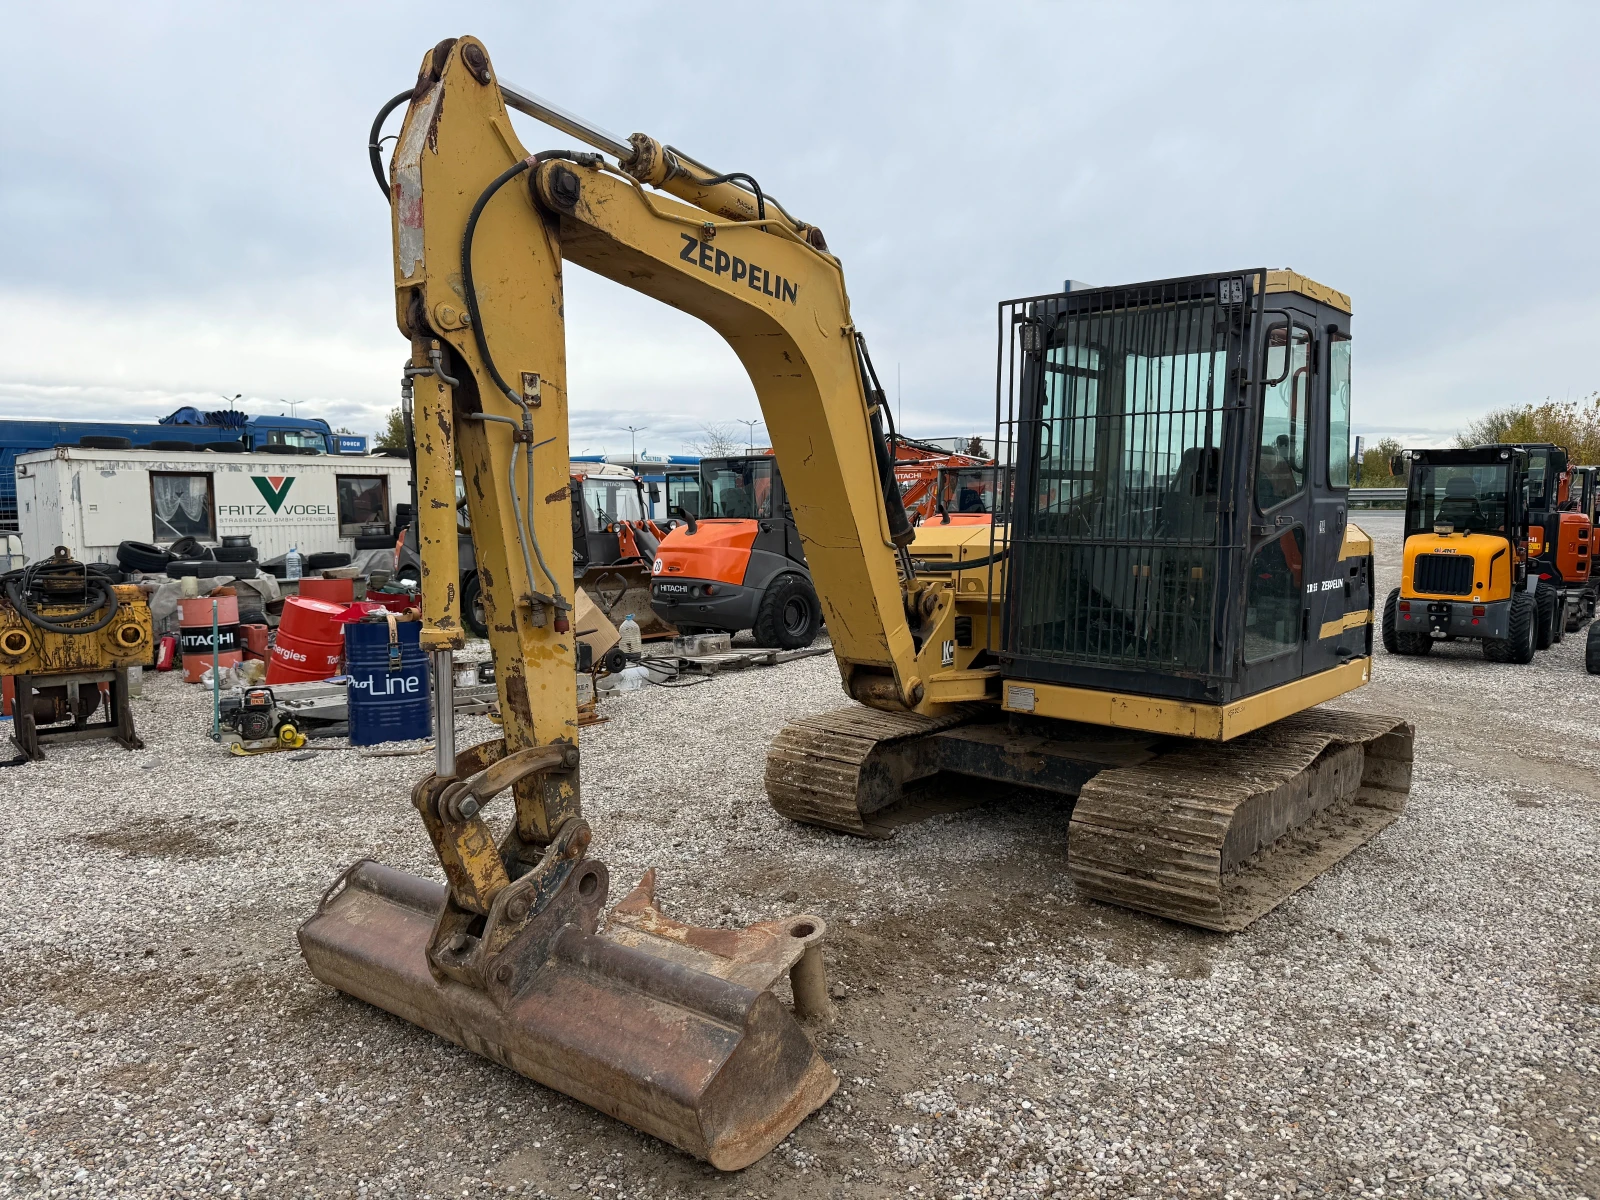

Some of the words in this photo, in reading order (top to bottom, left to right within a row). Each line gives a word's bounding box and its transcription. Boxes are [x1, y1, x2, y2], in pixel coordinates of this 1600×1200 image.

[680, 232, 798, 306] ZEPPELIN
[218, 505, 267, 516] FRITZ
[283, 504, 336, 515] VOGEL
[660, 584, 688, 593] HITACHI
[1321, 578, 1344, 591] ZEPPELIN
